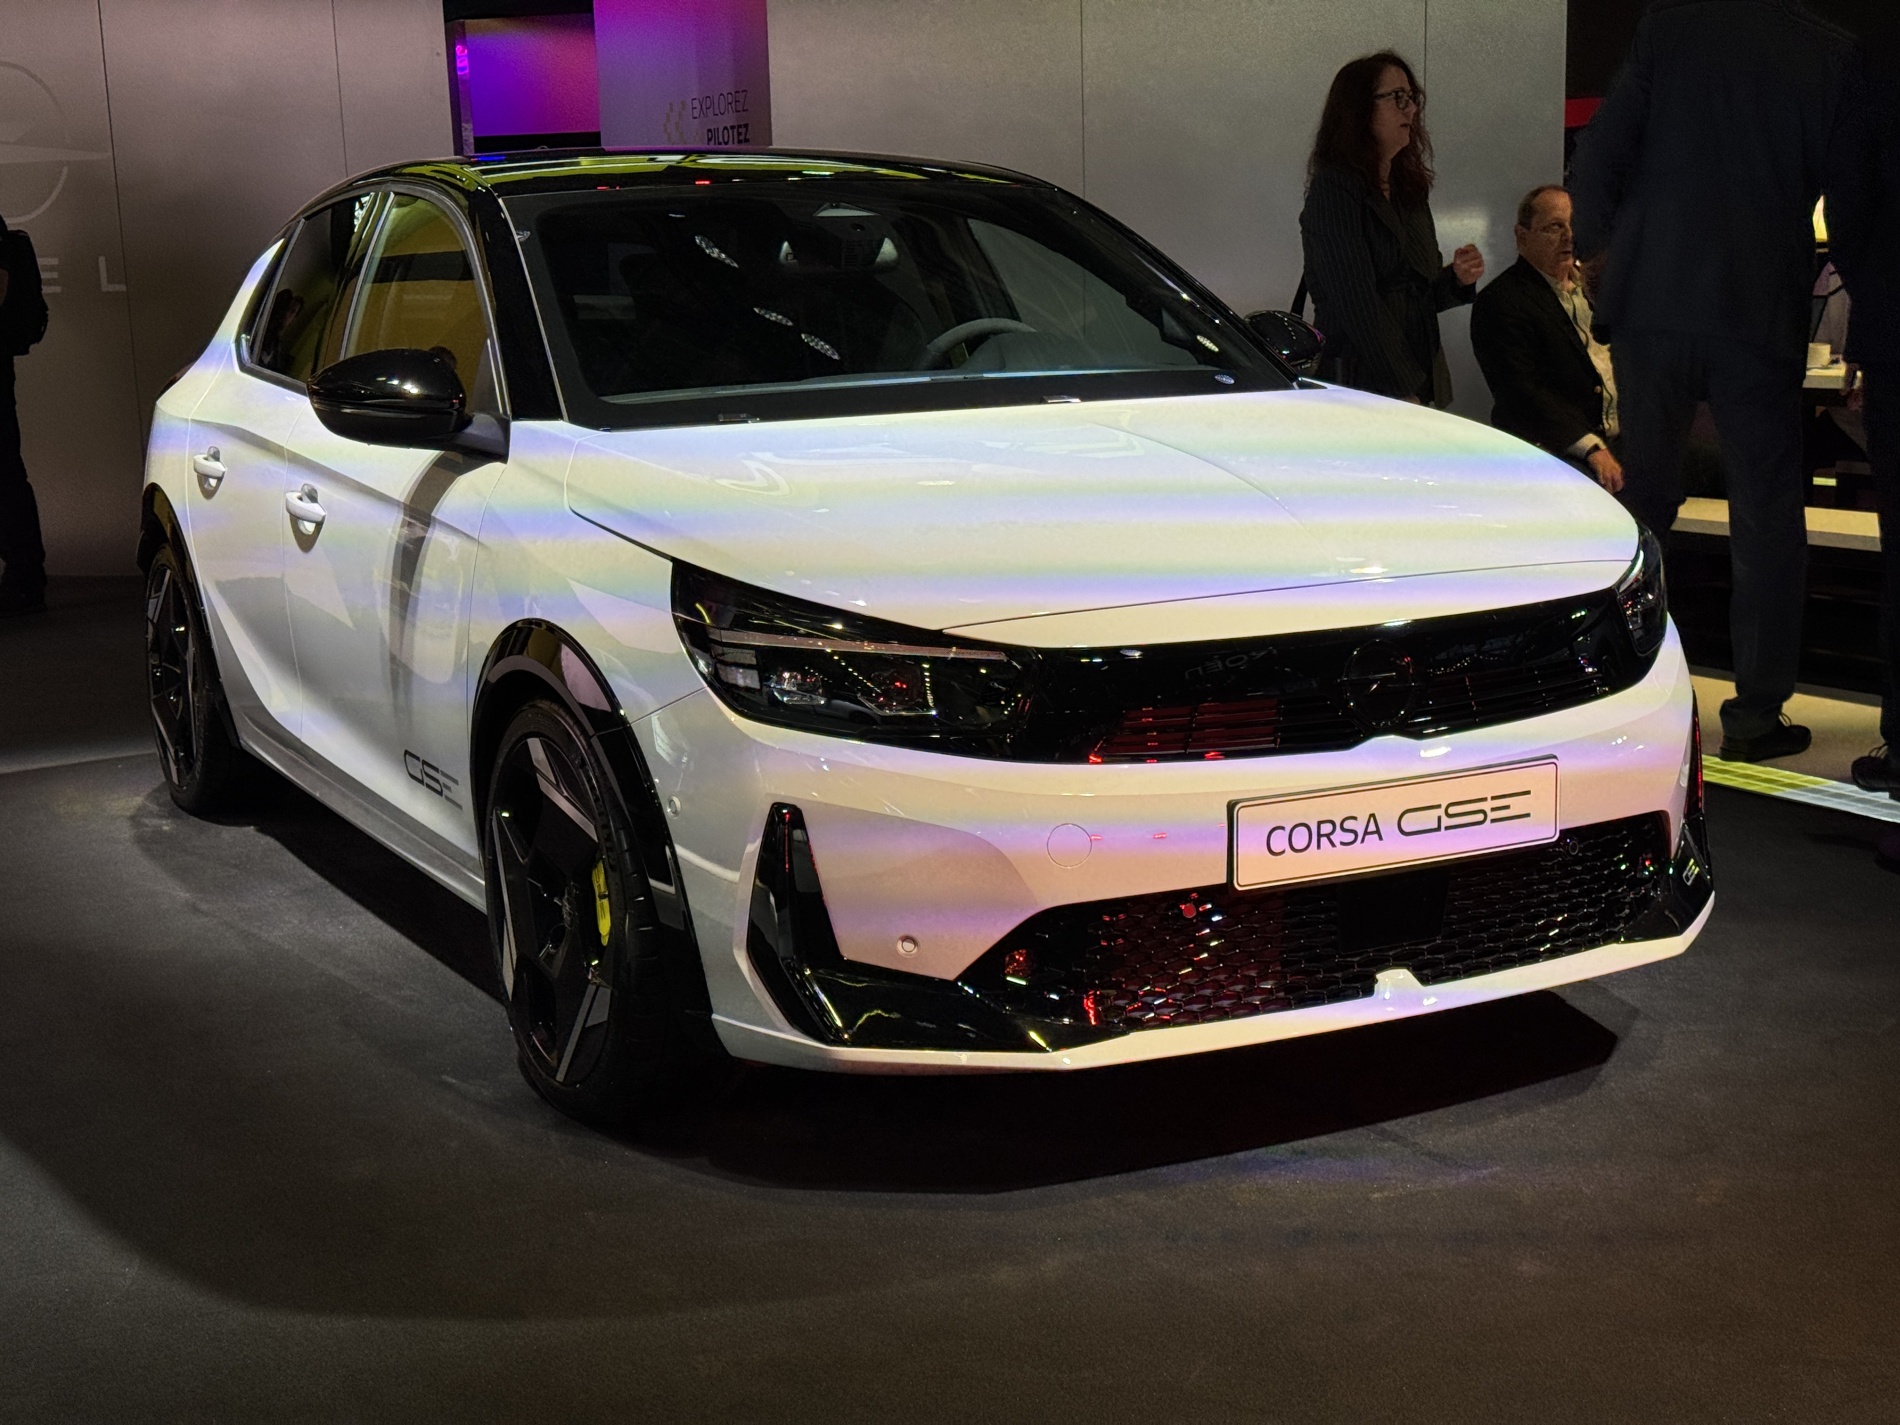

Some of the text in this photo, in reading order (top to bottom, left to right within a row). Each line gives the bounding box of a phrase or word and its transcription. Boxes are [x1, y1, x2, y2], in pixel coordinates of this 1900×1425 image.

[691, 90, 748, 119] EXPLOREZ
[707, 123, 749, 146] PILOTEZ
[404, 749, 463, 811] GSE
[1266, 790, 1531, 857] CORSA GSE
